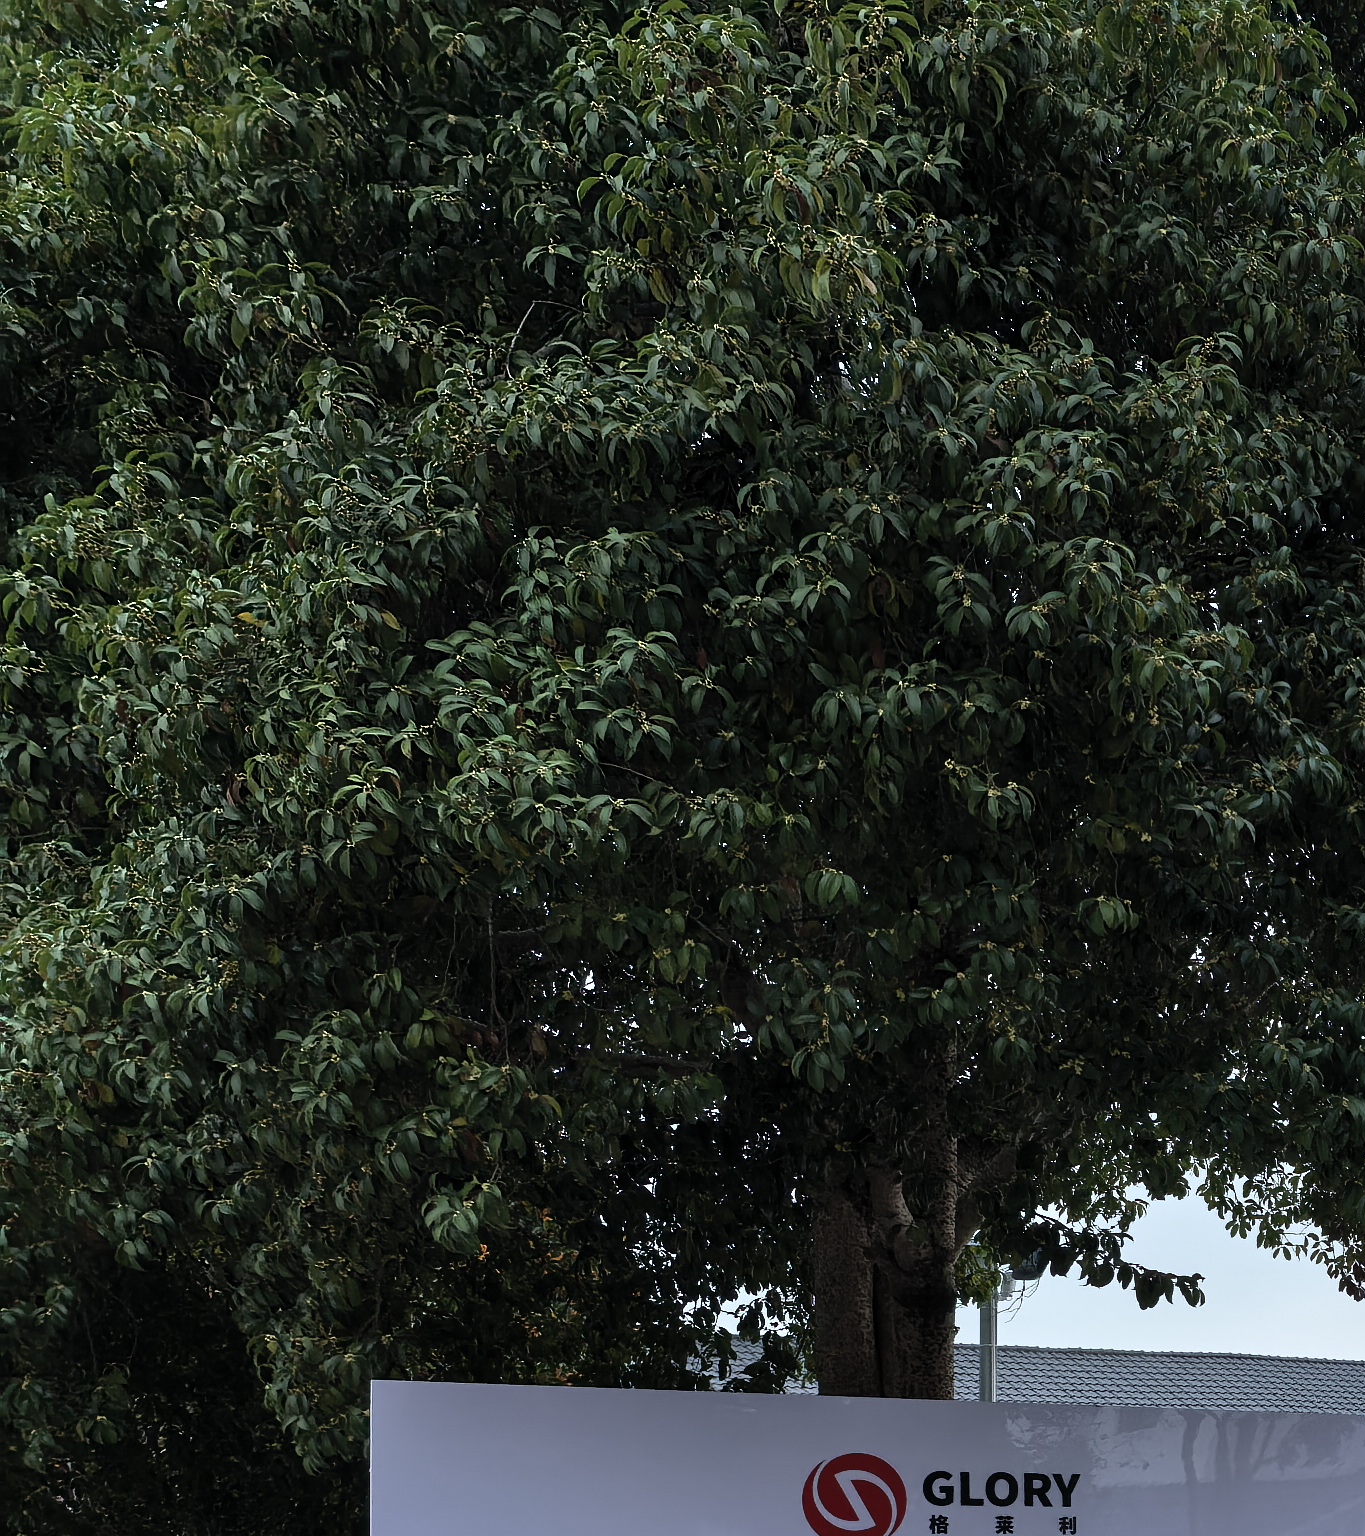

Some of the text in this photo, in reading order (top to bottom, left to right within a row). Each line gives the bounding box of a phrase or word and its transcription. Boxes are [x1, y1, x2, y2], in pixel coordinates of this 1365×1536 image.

[922, 1470, 1082, 1508] GLORY
[928, 1514, 1078, 1536] 格莱利
